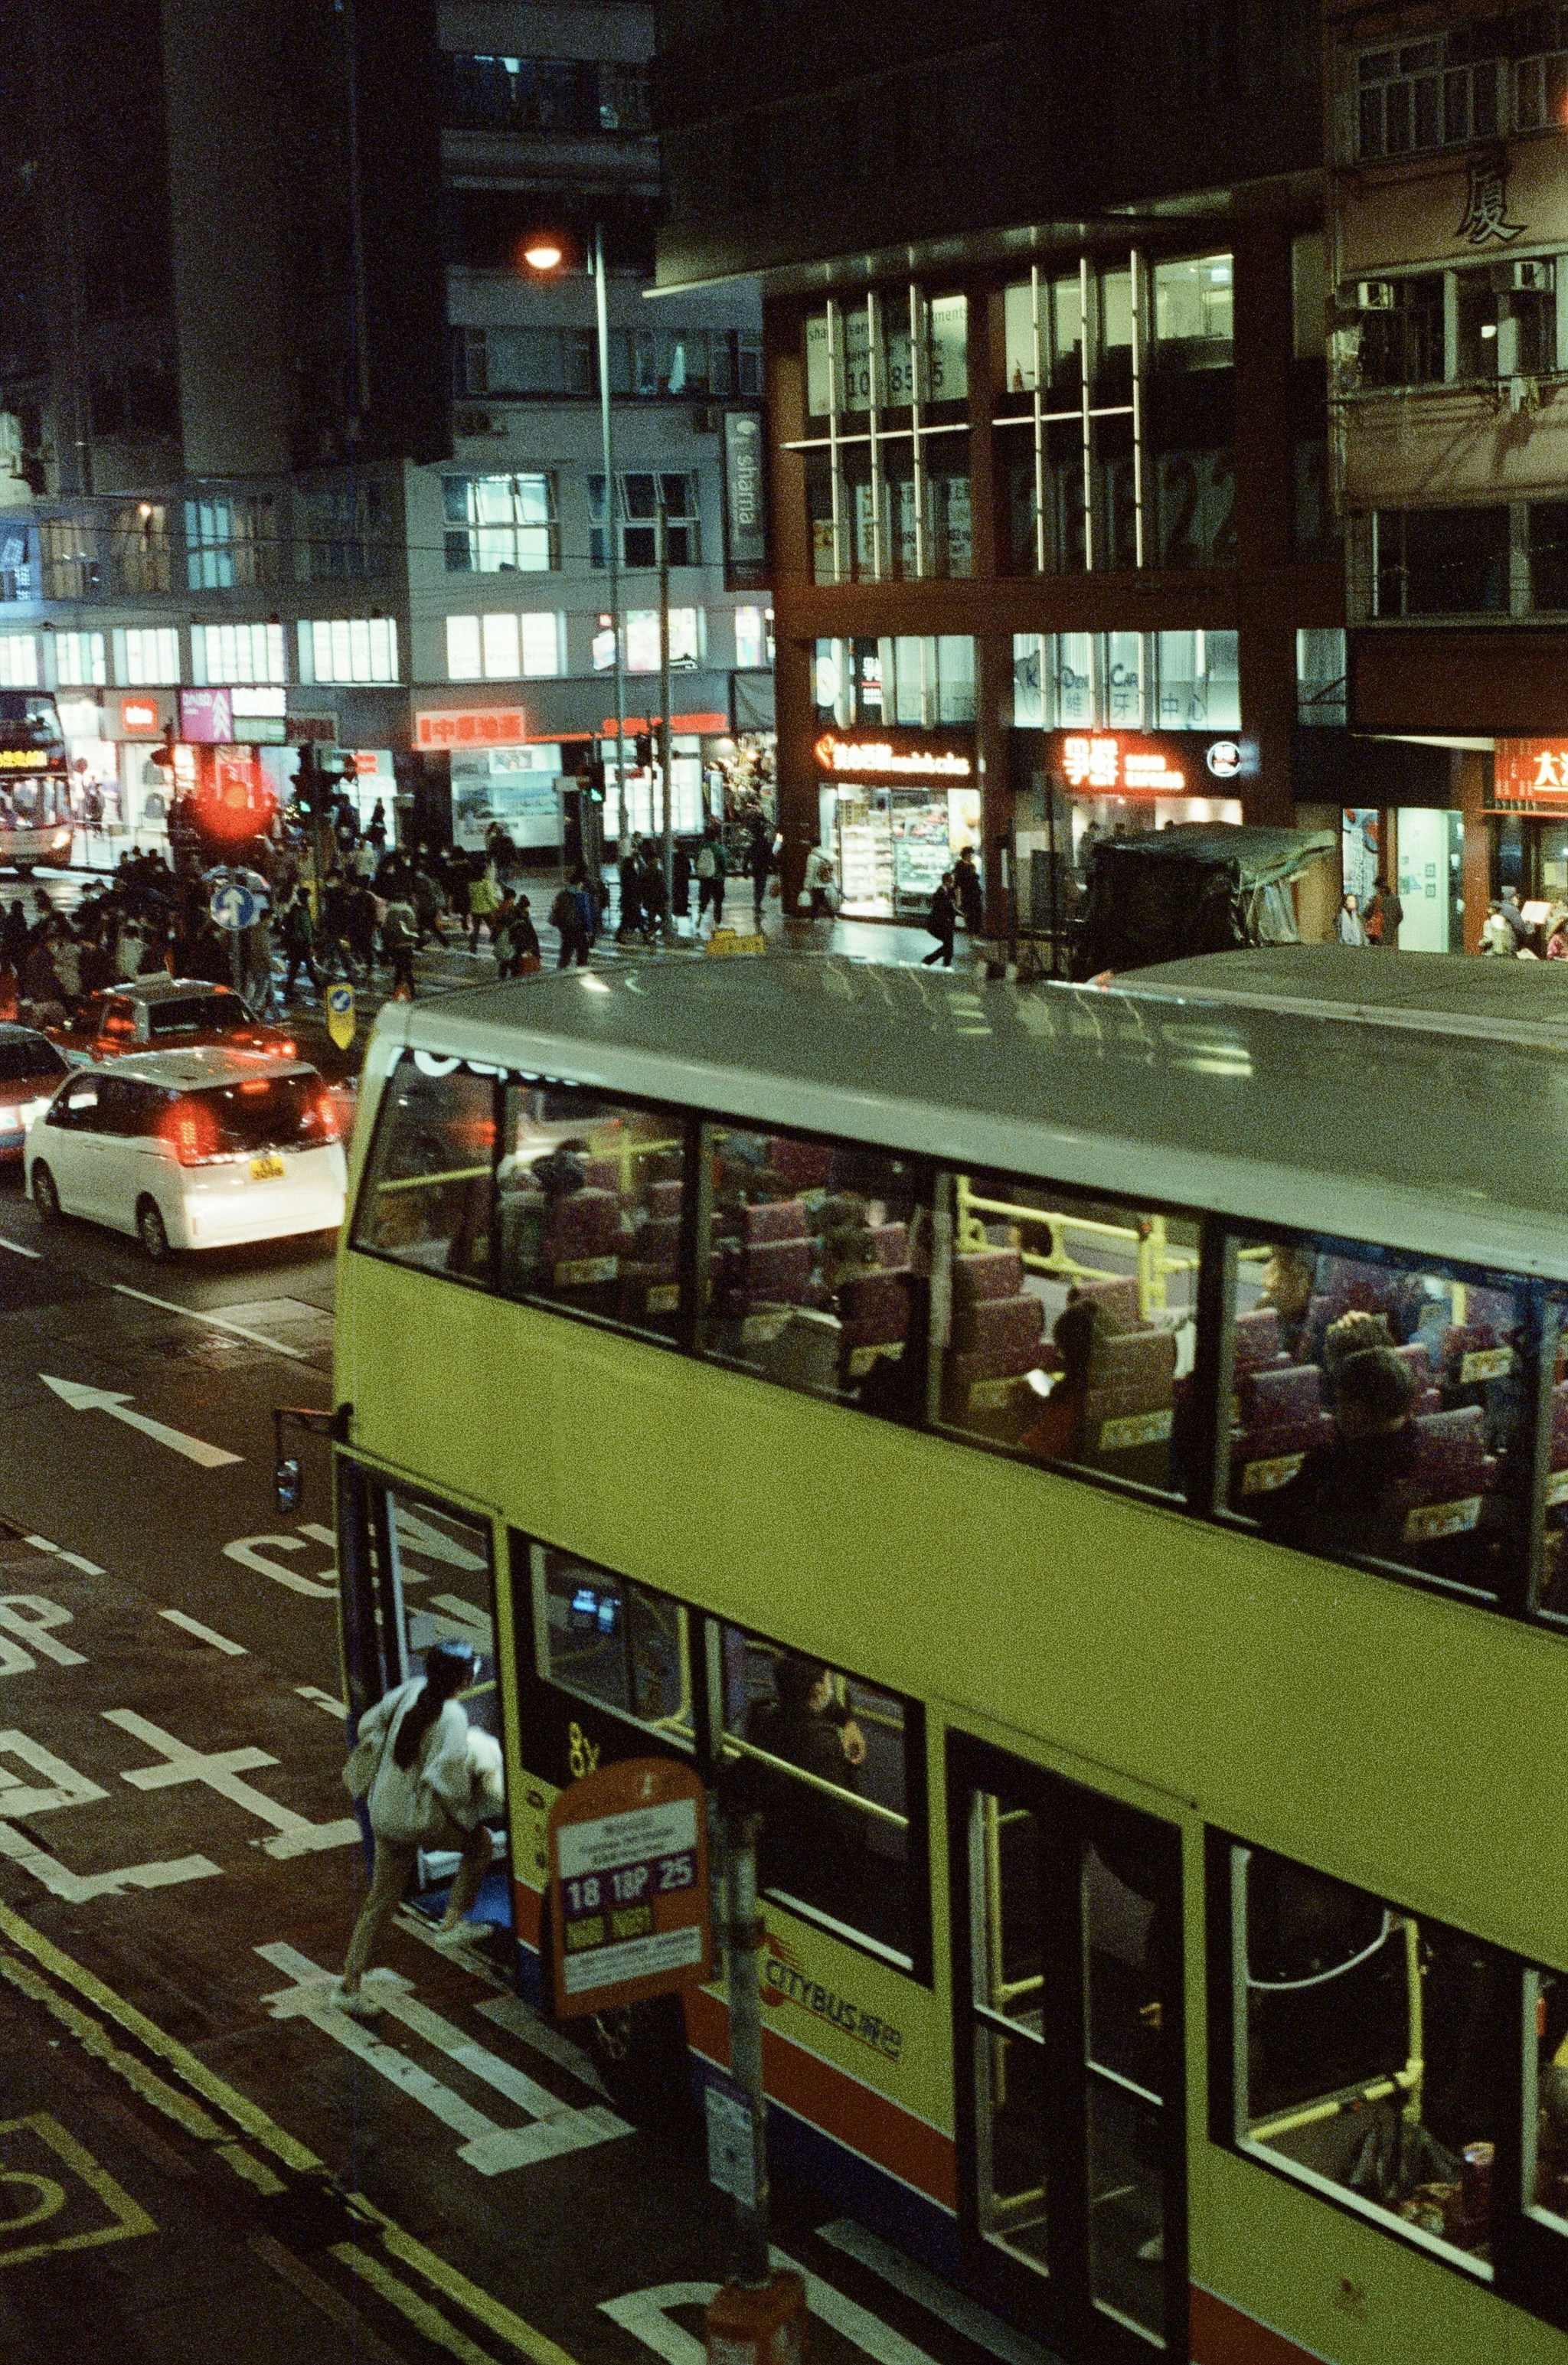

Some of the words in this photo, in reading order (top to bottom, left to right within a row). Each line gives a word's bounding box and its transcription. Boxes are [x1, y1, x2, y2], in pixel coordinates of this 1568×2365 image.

[567, 1876, 601, 1912] 18
[612, 1864, 649, 1901] 18P
[658, 1854, 693, 1890] 25
[766, 1958, 857, 2031] CITYBUS
